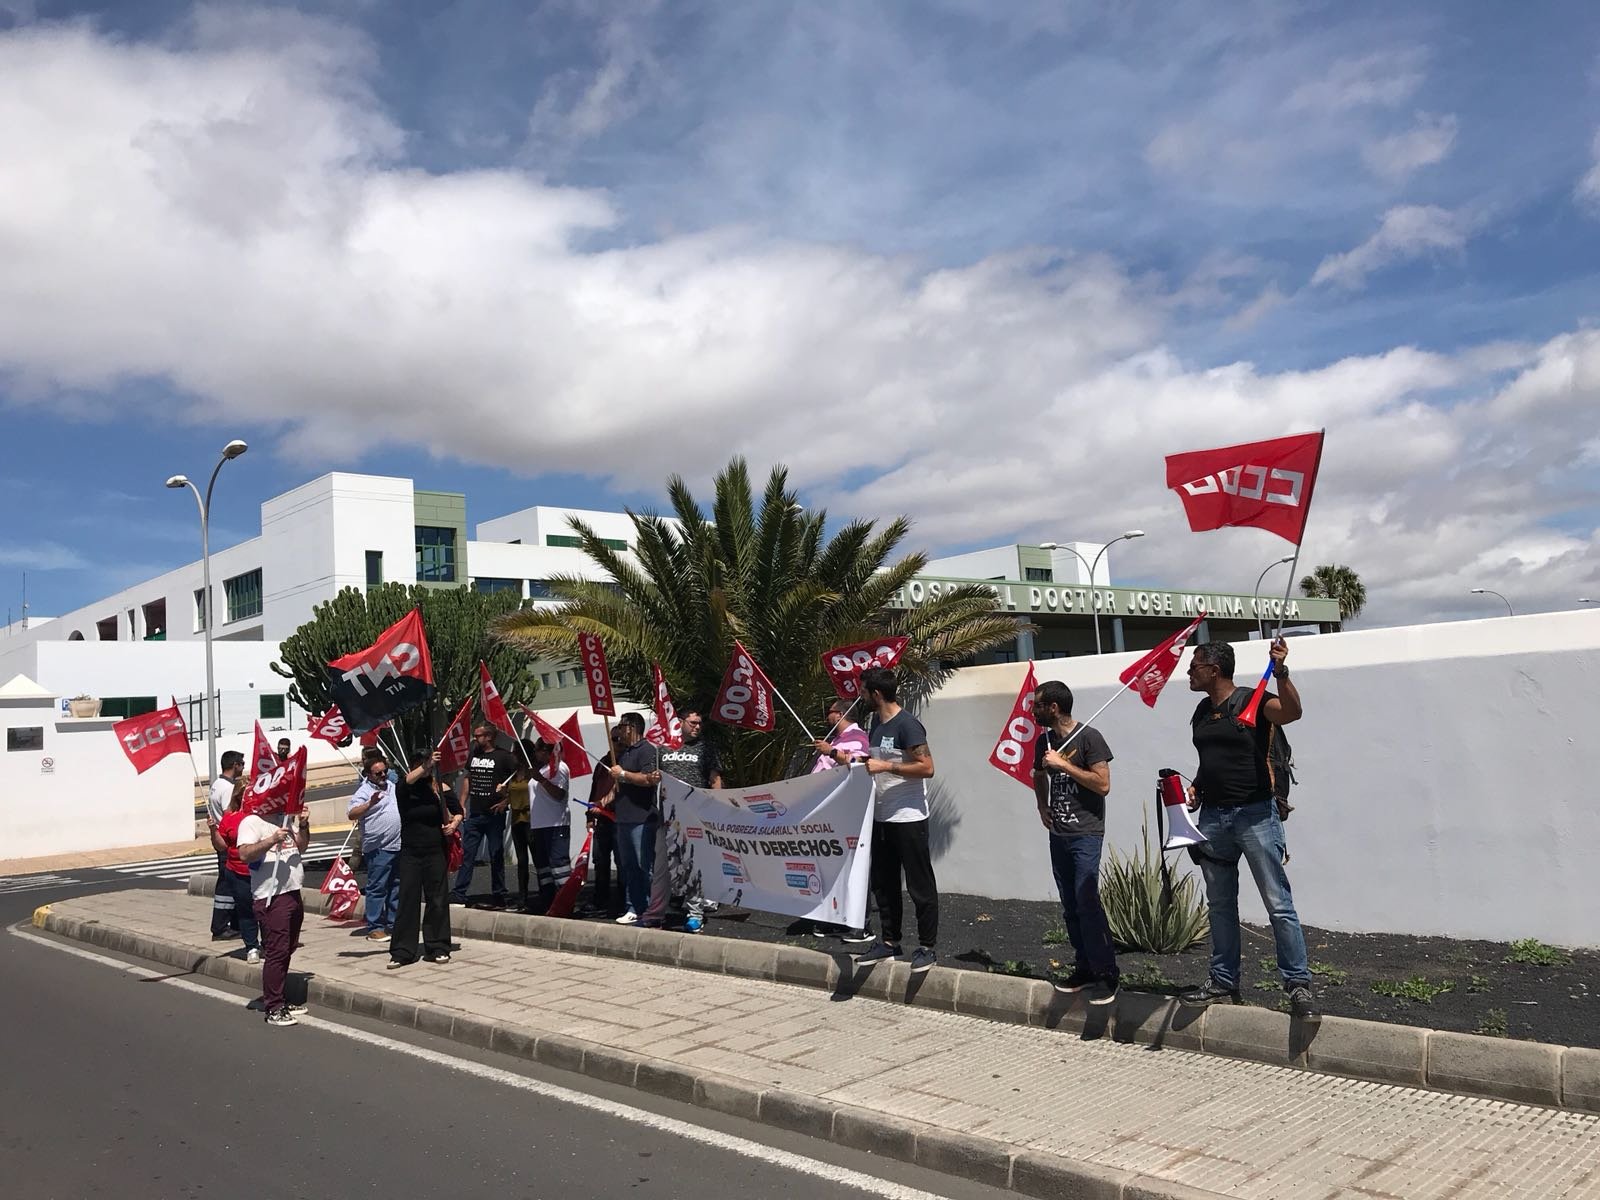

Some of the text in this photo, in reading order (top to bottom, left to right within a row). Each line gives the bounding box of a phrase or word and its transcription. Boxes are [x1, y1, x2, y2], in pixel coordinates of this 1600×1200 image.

[1030, 587, 1116, 611] DOCTOR
[1128, 592, 1173, 612] JOSE
[1180, 594, 1245, 616] MOLINA
[662, 751, 700, 763] adidas
[717, 823, 725, 832] LA
[726, 824, 757, 835] POBREZA
[758, 826, 792, 836] SALARIAL
[792, 825, 799, 835] Y
[800, 823, 835, 834] SOCIAL
[748, 839, 759, 855] Y
[759, 838, 844, 857] DERECHOS
